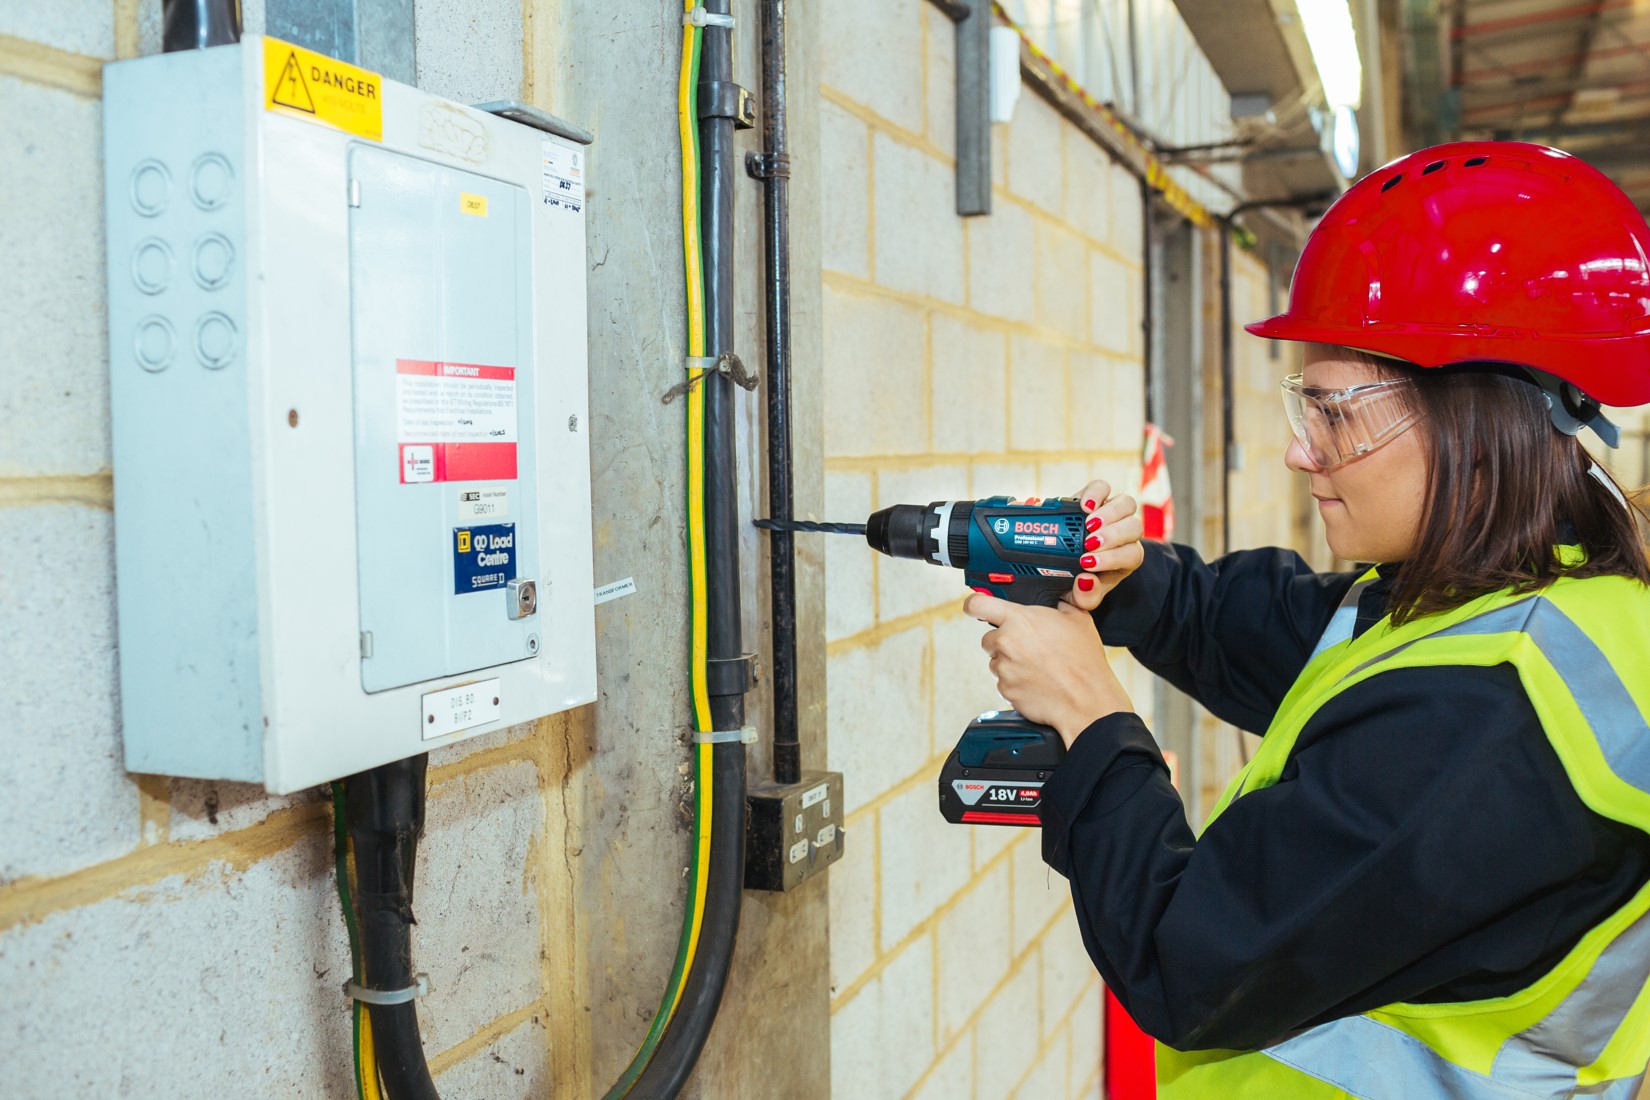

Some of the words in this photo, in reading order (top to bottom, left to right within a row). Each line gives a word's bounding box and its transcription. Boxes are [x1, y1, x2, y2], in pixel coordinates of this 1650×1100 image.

[312, 66, 376, 99] DANGER
[444, 365, 480, 376] IMPORTANT
[1015, 521, 1059, 534] BOSCH
[489, 533, 513, 550] Load
[477, 550, 509, 567] Centre
[472, 573, 498, 588] SQUARE
[596, 582, 633, 597] TRANSFORMER
[989, 788, 1017, 801] 18V
